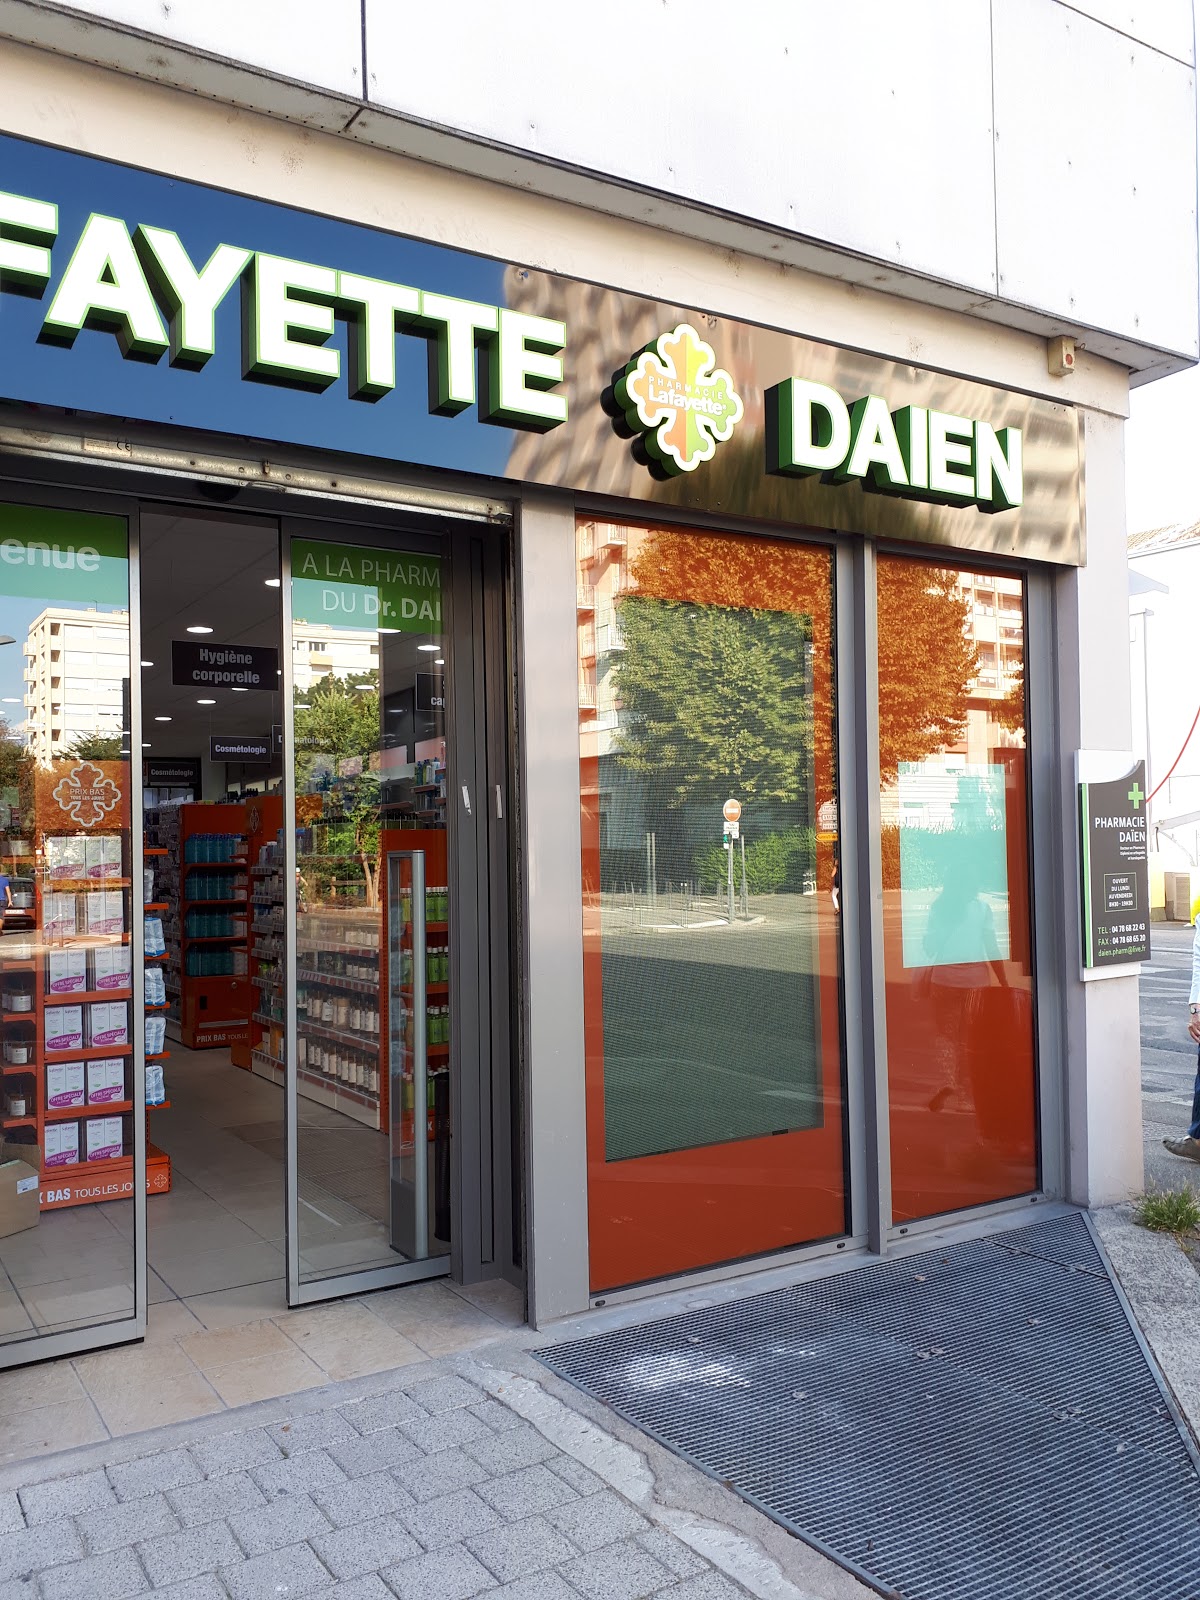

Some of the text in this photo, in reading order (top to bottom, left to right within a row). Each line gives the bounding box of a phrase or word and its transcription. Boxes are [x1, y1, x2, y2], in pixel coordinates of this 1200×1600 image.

[648, 375, 723, 400] PHARMACIE
[648, 384, 724, 416] Lafayette
[791, 376, 1024, 506] DAIEN
[0, 538, 101, 572] enue
[301, 552, 441, 588] A LA PHARM
[322, 589, 356, 613] DU
[364, 593, 397, 618] Dr.
[199, 648, 253, 665] Hygiène
[192, 669, 260, 684] corporelle
[214, 744, 267, 755] Cosmétologie
[150, 768, 194, 777] Cosmétologie
[1094, 816, 1145, 829] PHARMACIE
[1119, 829, 1146, 843] DAÏEN
[1097, 926, 1109, 934] TEL
[1111, 925, 1118, 933] 04
[1119, 924, 1125, 932] 78
[1132, 923, 1139, 931] 22
[1112, 937, 1119, 945] 04
[46, 1187, 71, 1203] BAS
[74, 1186, 101, 1199] TOUS
[101, 1183, 119, 1195] LES
